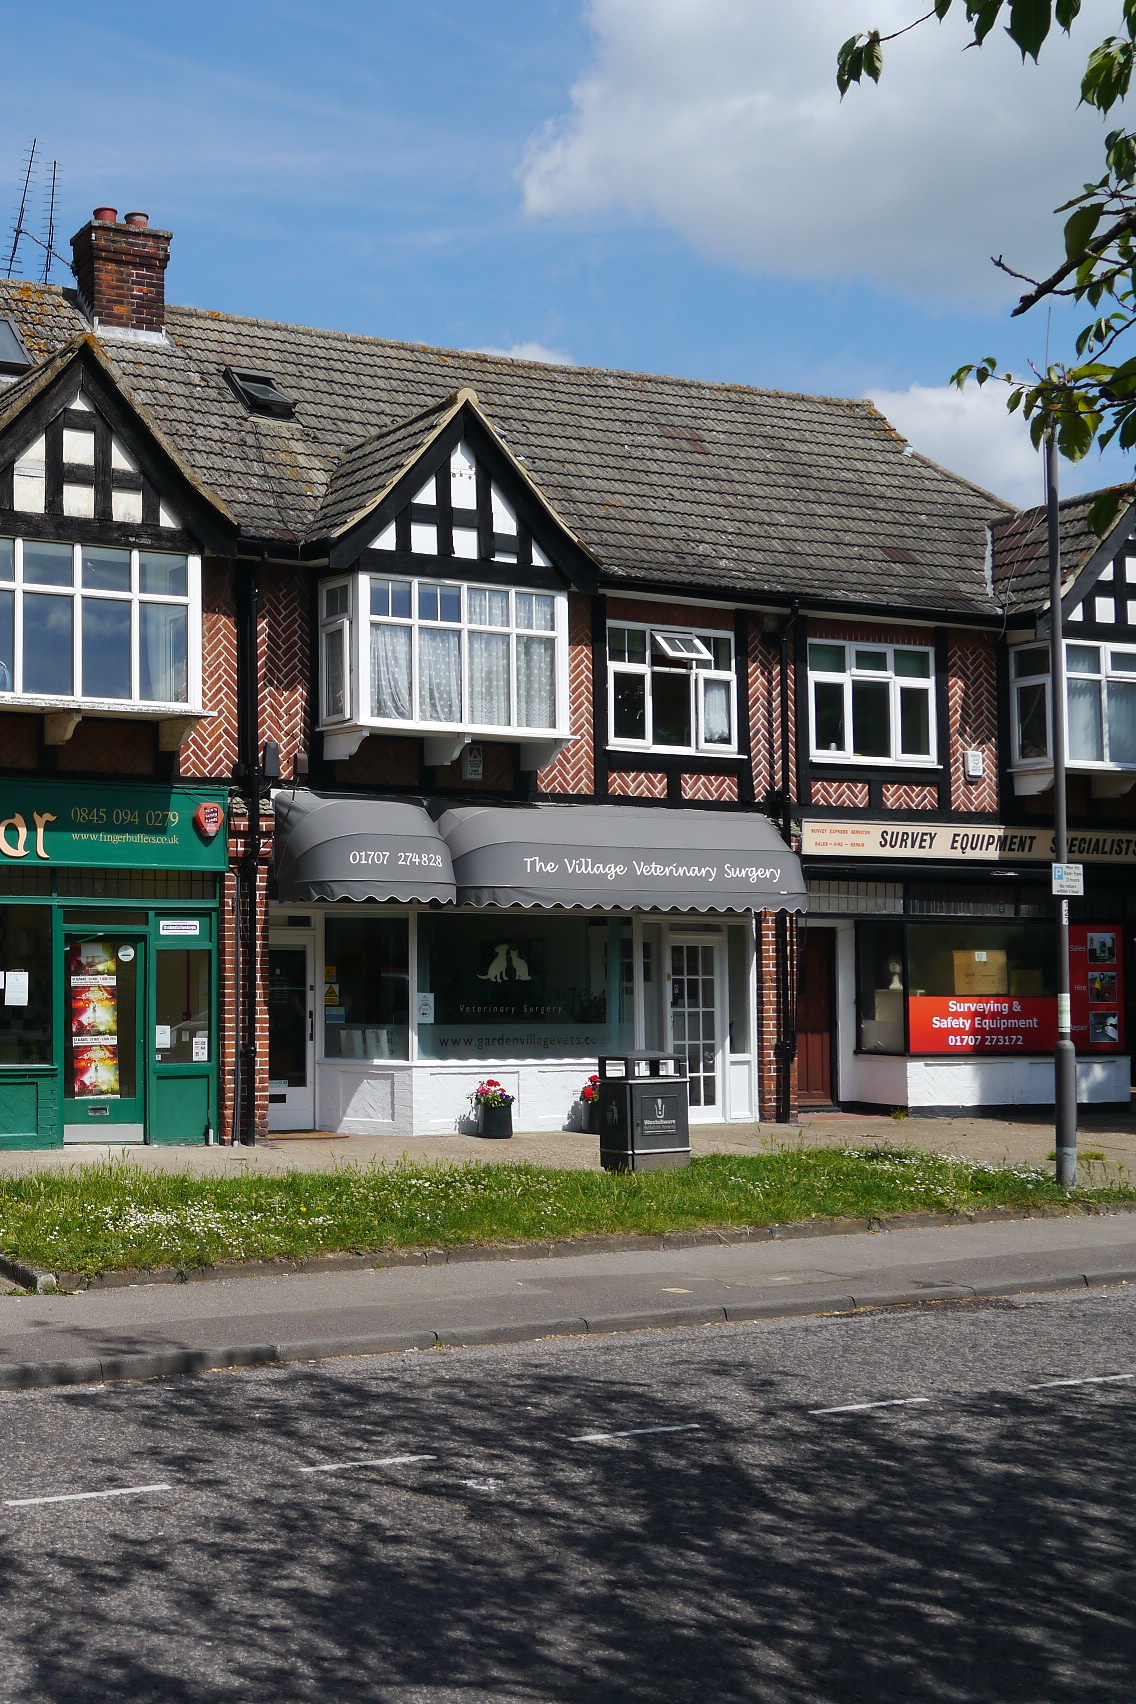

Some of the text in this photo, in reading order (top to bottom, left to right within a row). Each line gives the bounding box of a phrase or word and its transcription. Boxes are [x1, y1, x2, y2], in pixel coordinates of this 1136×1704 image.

[71, 807, 179, 827] 0845 094 0279
[878, 829, 1136, 857] SURVEY EQUIPMENT SECIALIST
[349, 851, 443, 867] 01707 274828
[523, 856, 781, 883] The Village Veterinary Surgery
[459, 1004, 562, 1015] Veterinary Surgery
[948, 1000, 1022, 1014] Surveying &
[932, 1017, 1039, 1031] Safety Equipment
[948, 1035, 1024, 1045] 01707 273172
